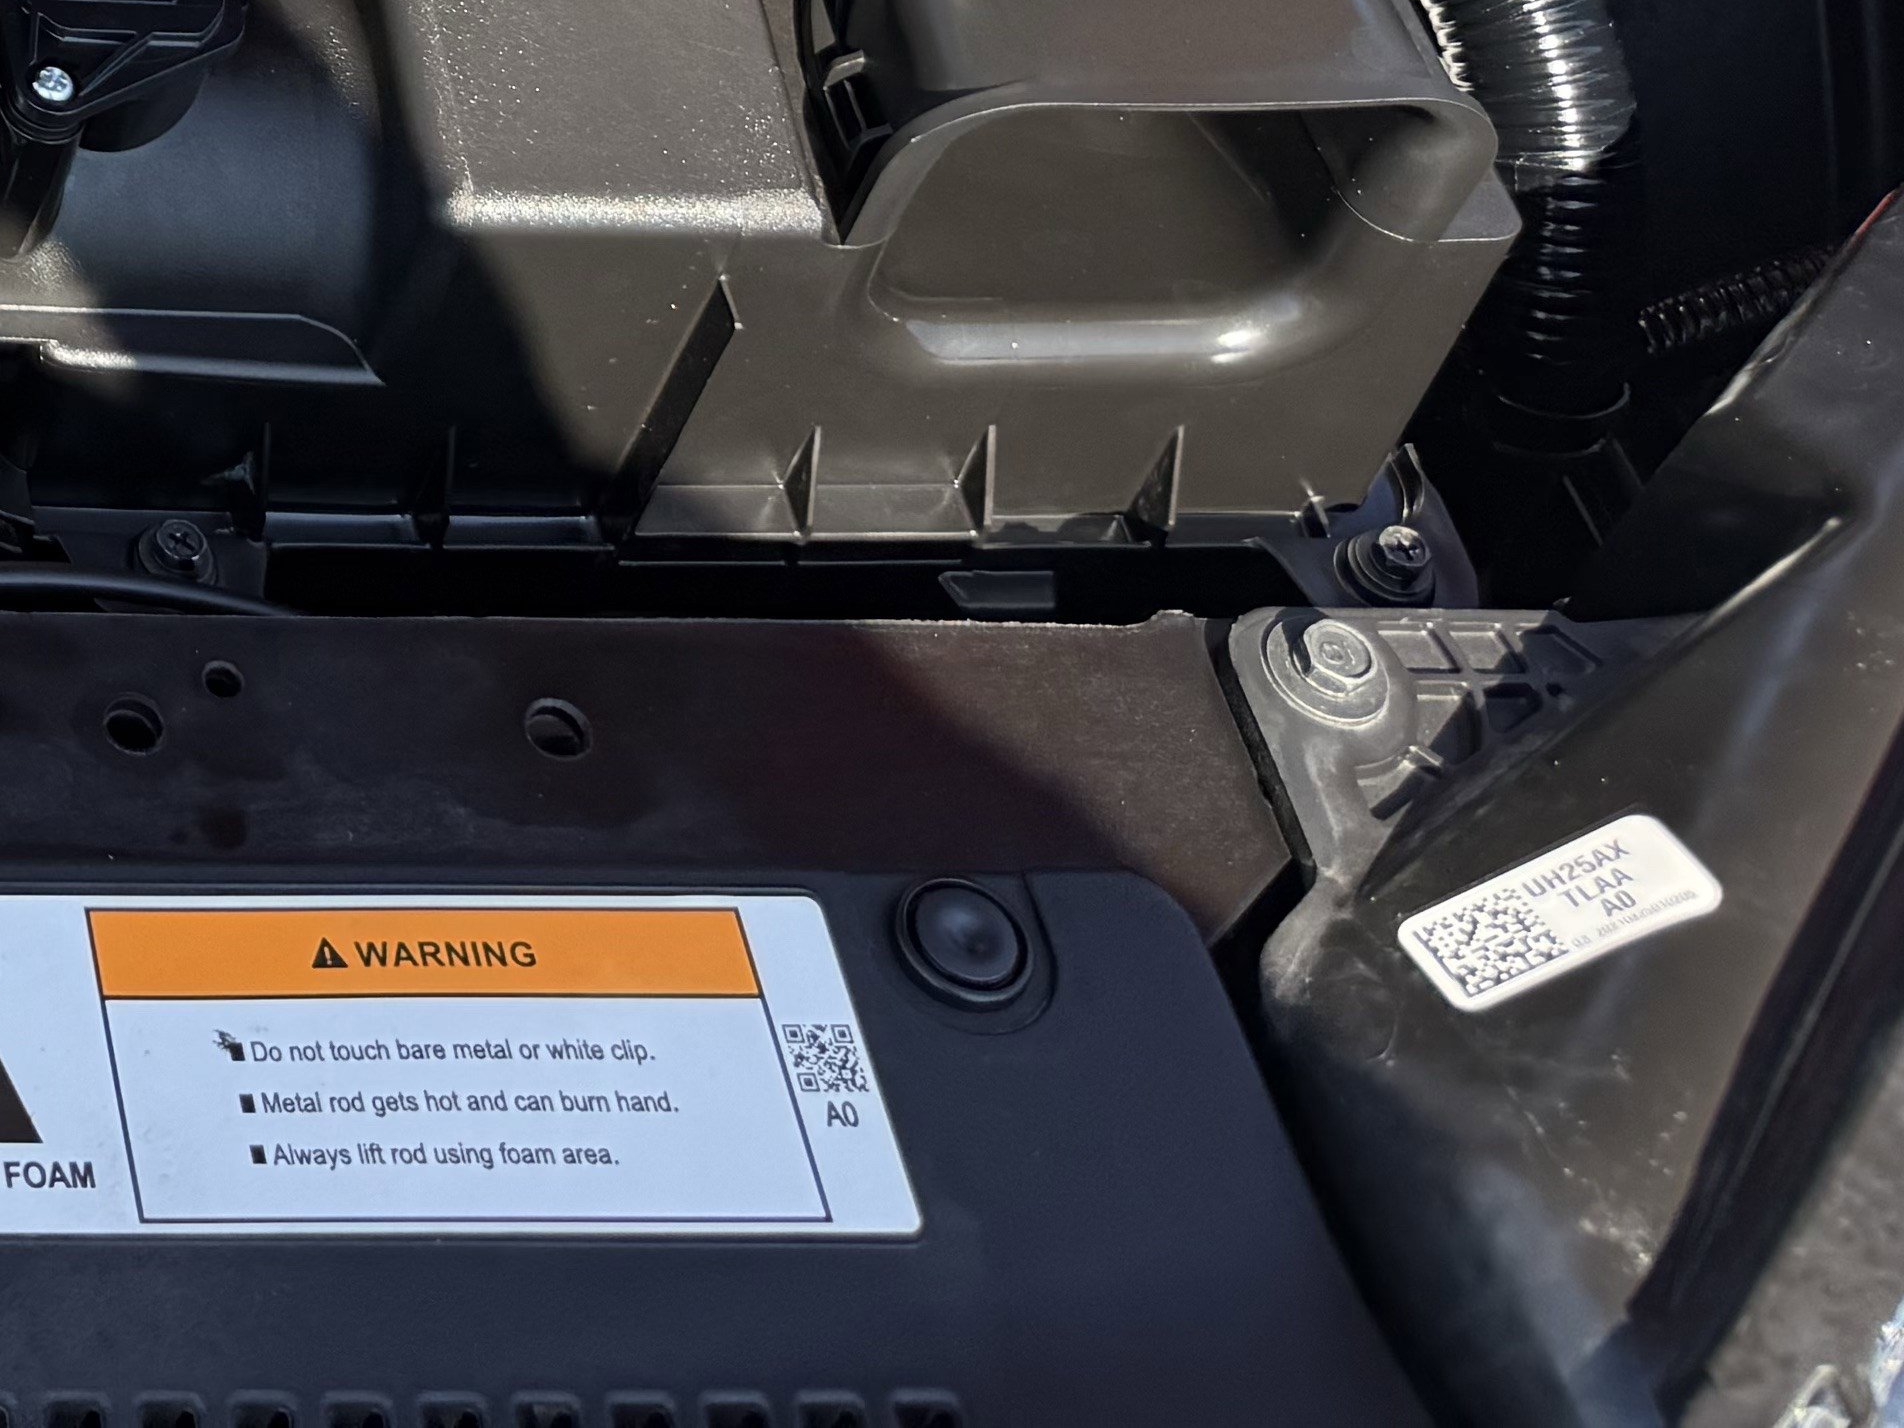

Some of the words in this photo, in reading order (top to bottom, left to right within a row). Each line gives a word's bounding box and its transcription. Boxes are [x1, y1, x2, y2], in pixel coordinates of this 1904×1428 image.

[1522, 837, 1631, 899] UH25AX
[1557, 867, 1634, 909] TLAA
[354, 936, 538, 971] WARNING
[250, 1041, 282, 1062] Do
[289, 1041, 325, 1062] not
[329, 1039, 391, 1061] touch
[395, 1038, 446, 1060] bare
[453, 1038, 513, 1060] metal
[518, 1042, 540, 1060] or
[546, 1038, 605, 1060] white
[611, 1039, 656, 1065] clip.
[261, 1092, 323, 1113] Metal
[329, 1091, 365, 1113] rod
[372, 1091, 419, 1117] gets
[423, 1089, 461, 1112] hot
[467, 1089, 508, 1112] and
[514, 1095, 554, 1112] can
[559, 1090, 610, 1112] burn
[614, 1090, 679, 1112] hand.
[273, 1142, 352, 1171] Always
[357, 1142, 386, 1164] lift
[390, 1142, 427, 1164] rod
[433, 1142, 494, 1171] using
[499, 1141, 556, 1164] foam
[562, 1147, 620, 1165] area.
[3, 1161, 97, 1189] FOAM
